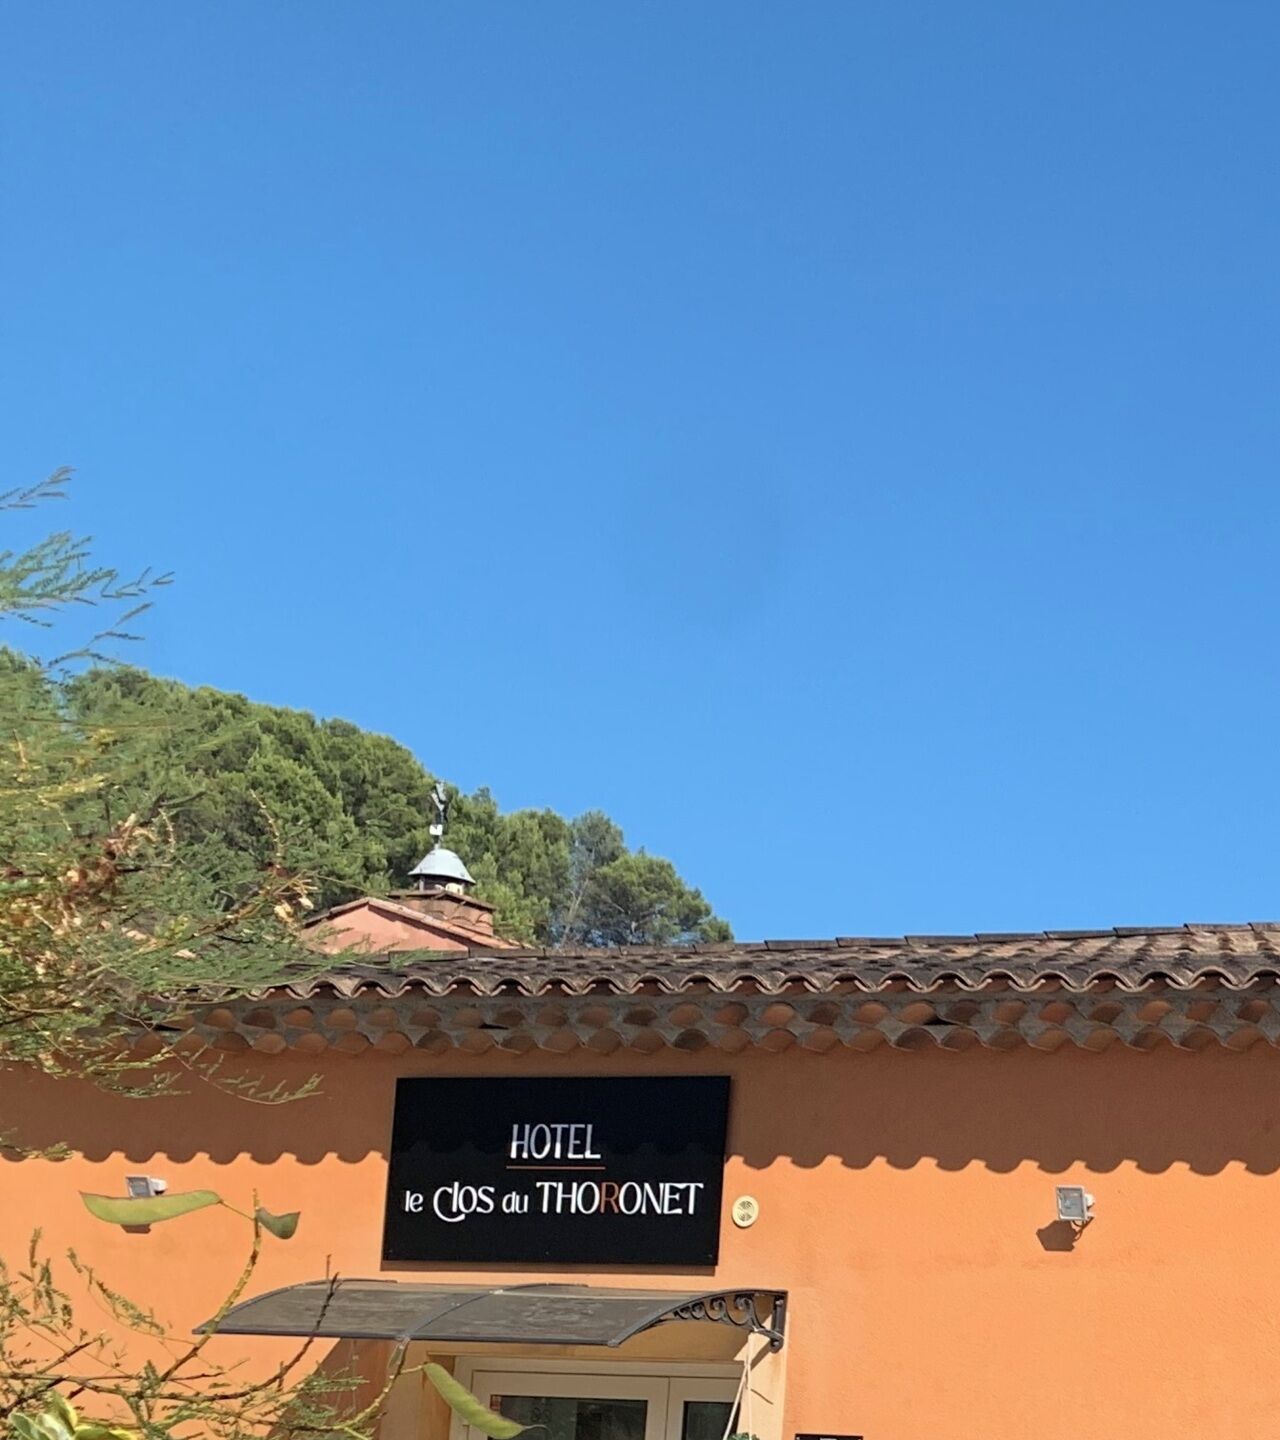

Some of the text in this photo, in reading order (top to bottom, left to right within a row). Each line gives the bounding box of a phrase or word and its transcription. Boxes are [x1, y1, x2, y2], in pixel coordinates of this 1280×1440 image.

[509, 1123, 601, 1160] HOTEL
[404, 1189, 424, 1213] le
[501, 1190, 529, 1214] du
[535, 1181, 704, 1216] THORONET
